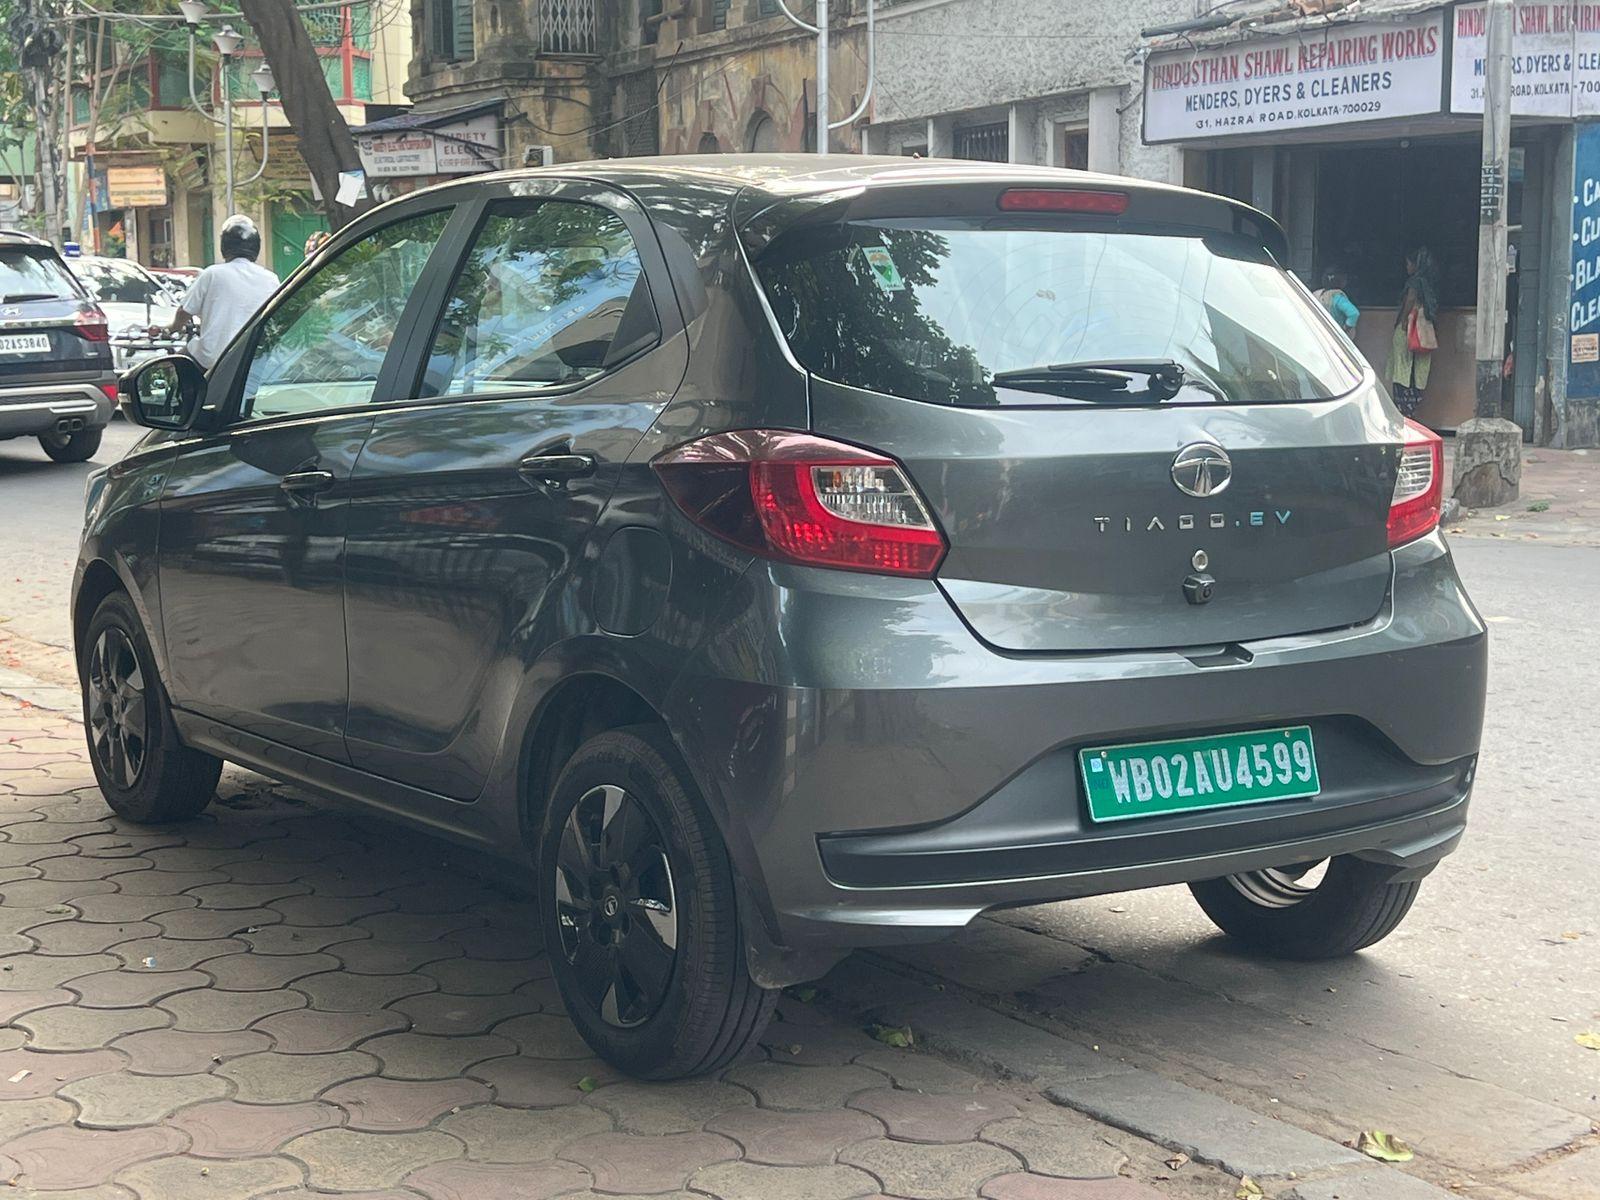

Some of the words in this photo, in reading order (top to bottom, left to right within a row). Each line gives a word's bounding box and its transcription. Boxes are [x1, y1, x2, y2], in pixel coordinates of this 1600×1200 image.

[1520, 5, 1551, 35] SHAWL
[1152, 54, 1240, 90] HINDUSTHAN
[1243, 47, 1294, 79] SHAWL
[1297, 34, 1378, 73] REPAIRING
[1382, 25, 1438, 61] WORKS
[1526, 54, 1562, 75] DYERS
[1563, 53, 1572, 72] &
[1185, 90, 1241, 113] MENDERS,
[1244, 83, 1291, 106] DYERS
[1296, 82, 1306, 100] &
[1311, 71, 1392, 98] CLEANERS
[1215, 115, 1255, 127] HAZRA
[1107, 740, 1311, 804] WB02AU4599
